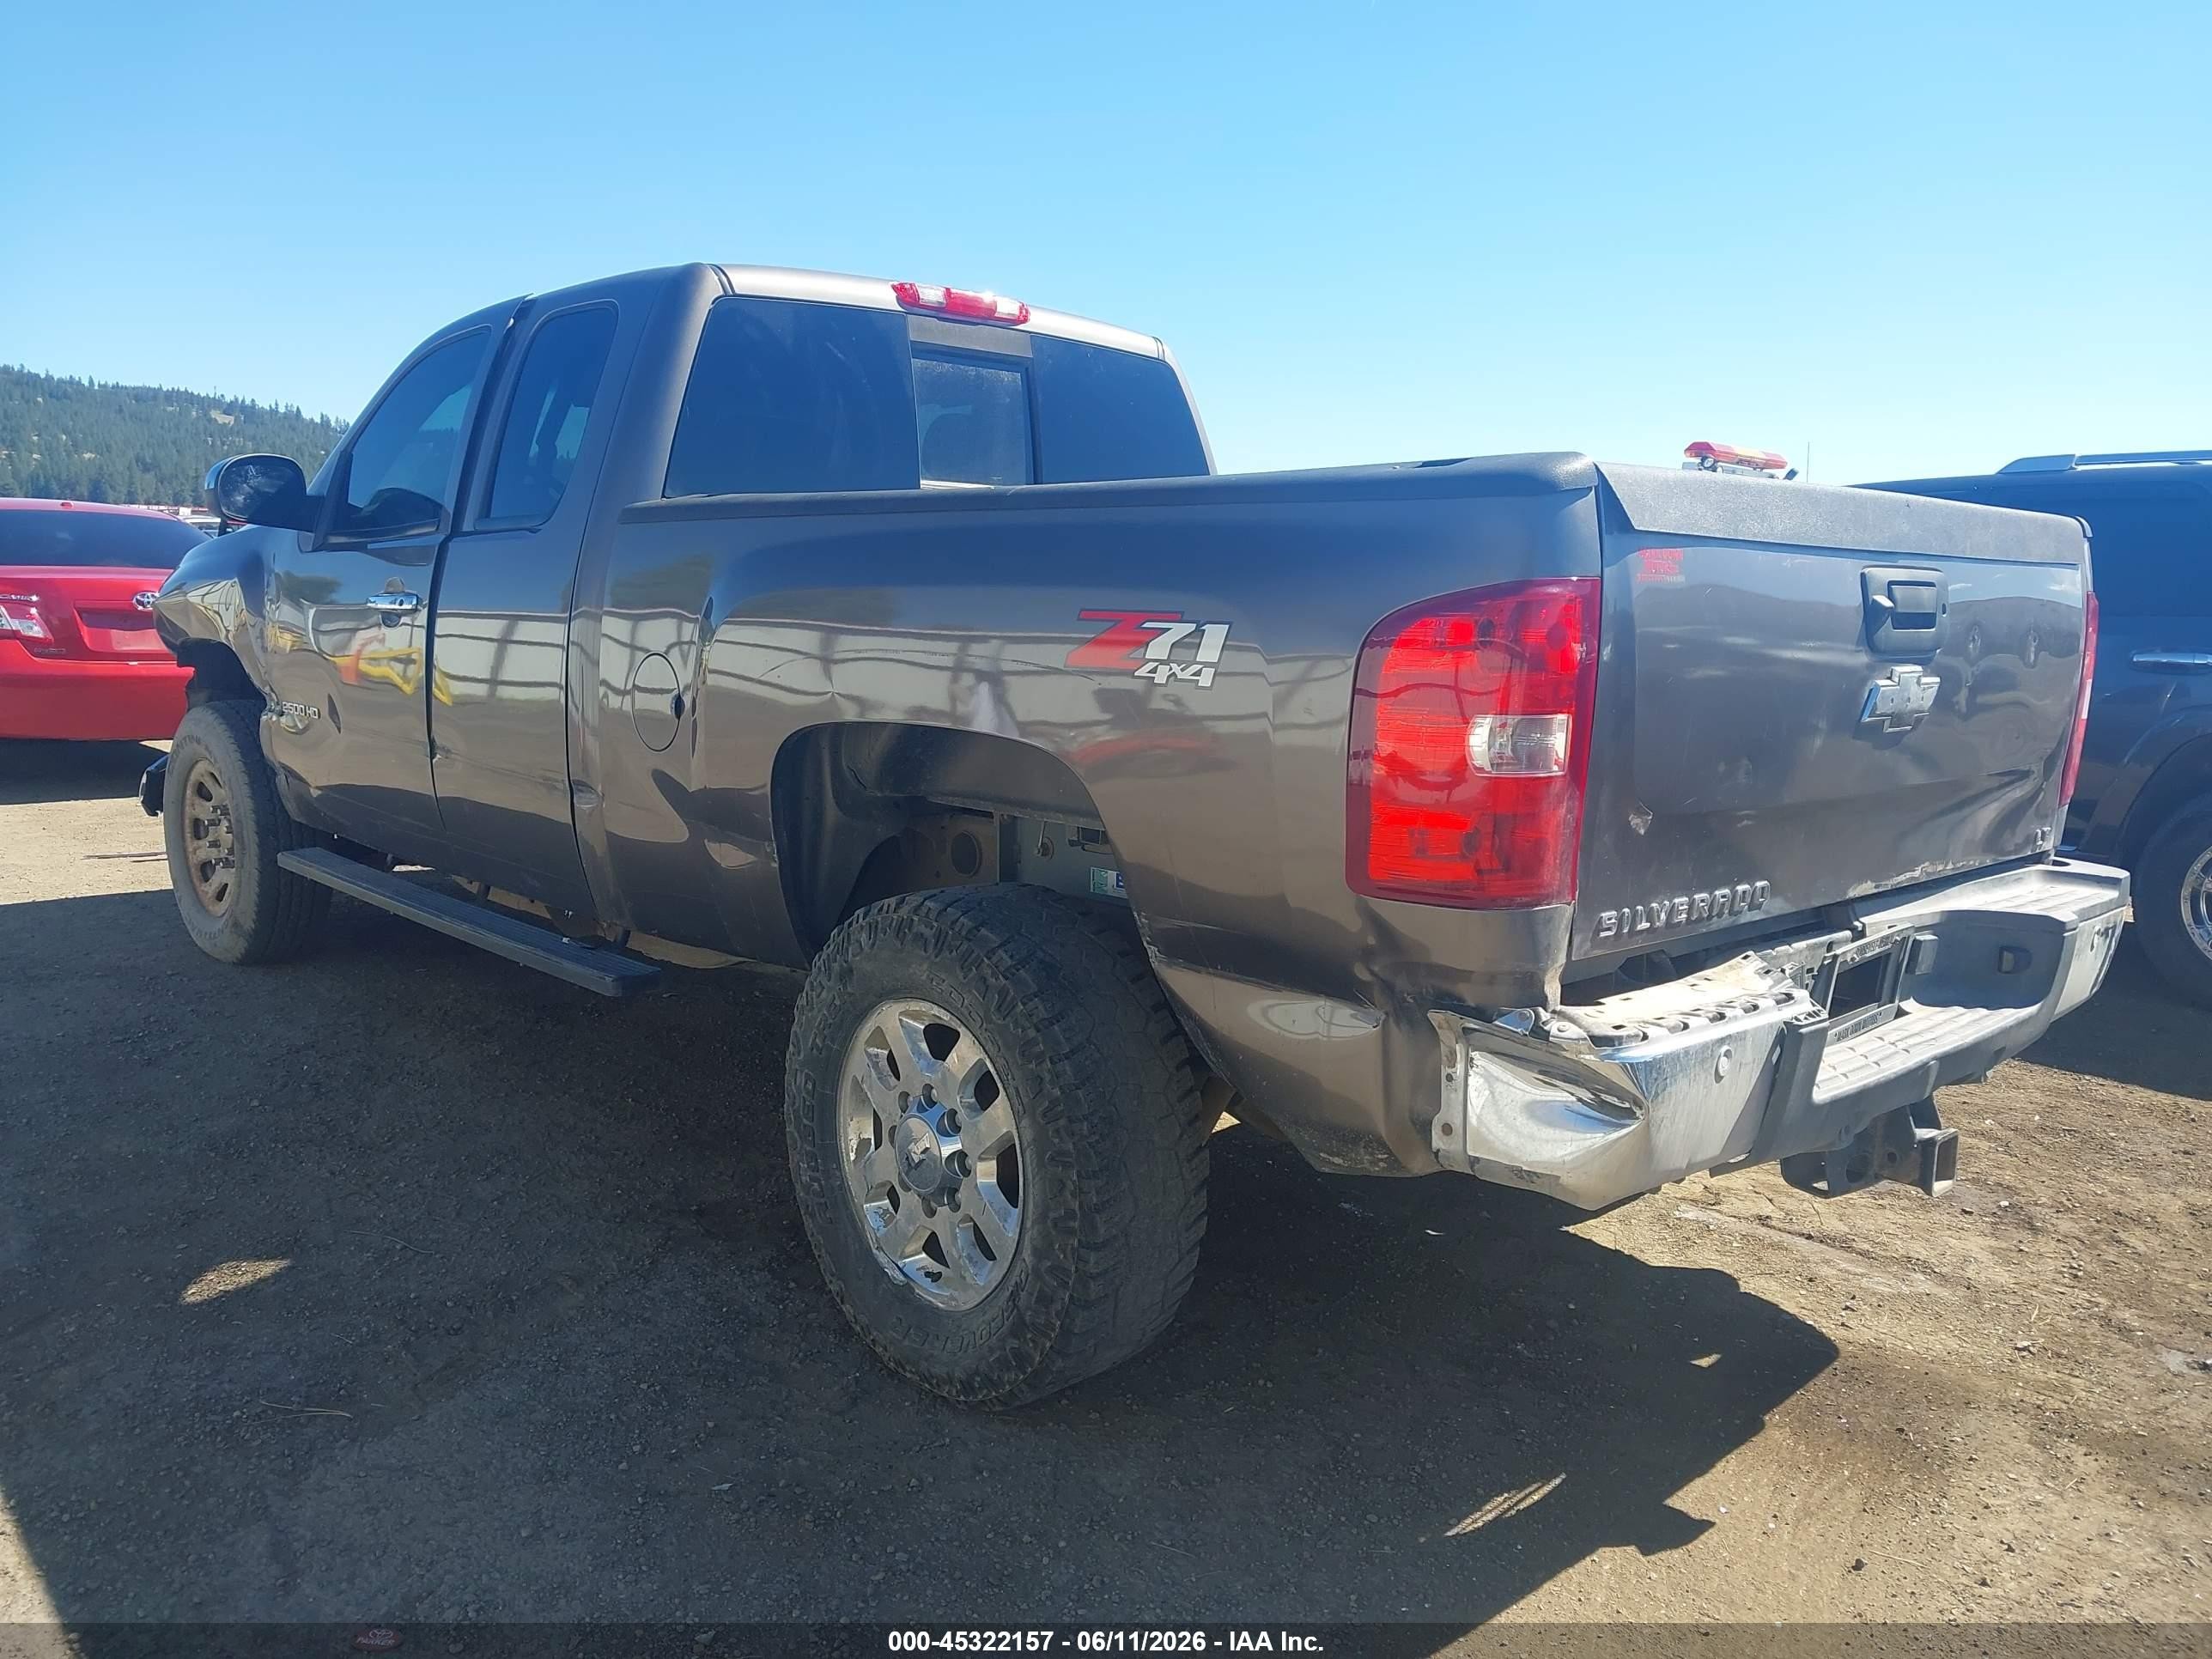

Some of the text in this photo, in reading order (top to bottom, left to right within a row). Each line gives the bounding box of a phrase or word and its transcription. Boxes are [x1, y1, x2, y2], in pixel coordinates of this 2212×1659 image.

[1065, 610, 1231, 669] Z71
[283, 701, 319, 720] 2500 HD
[1595, 879, 1771, 939] SILVERADO
